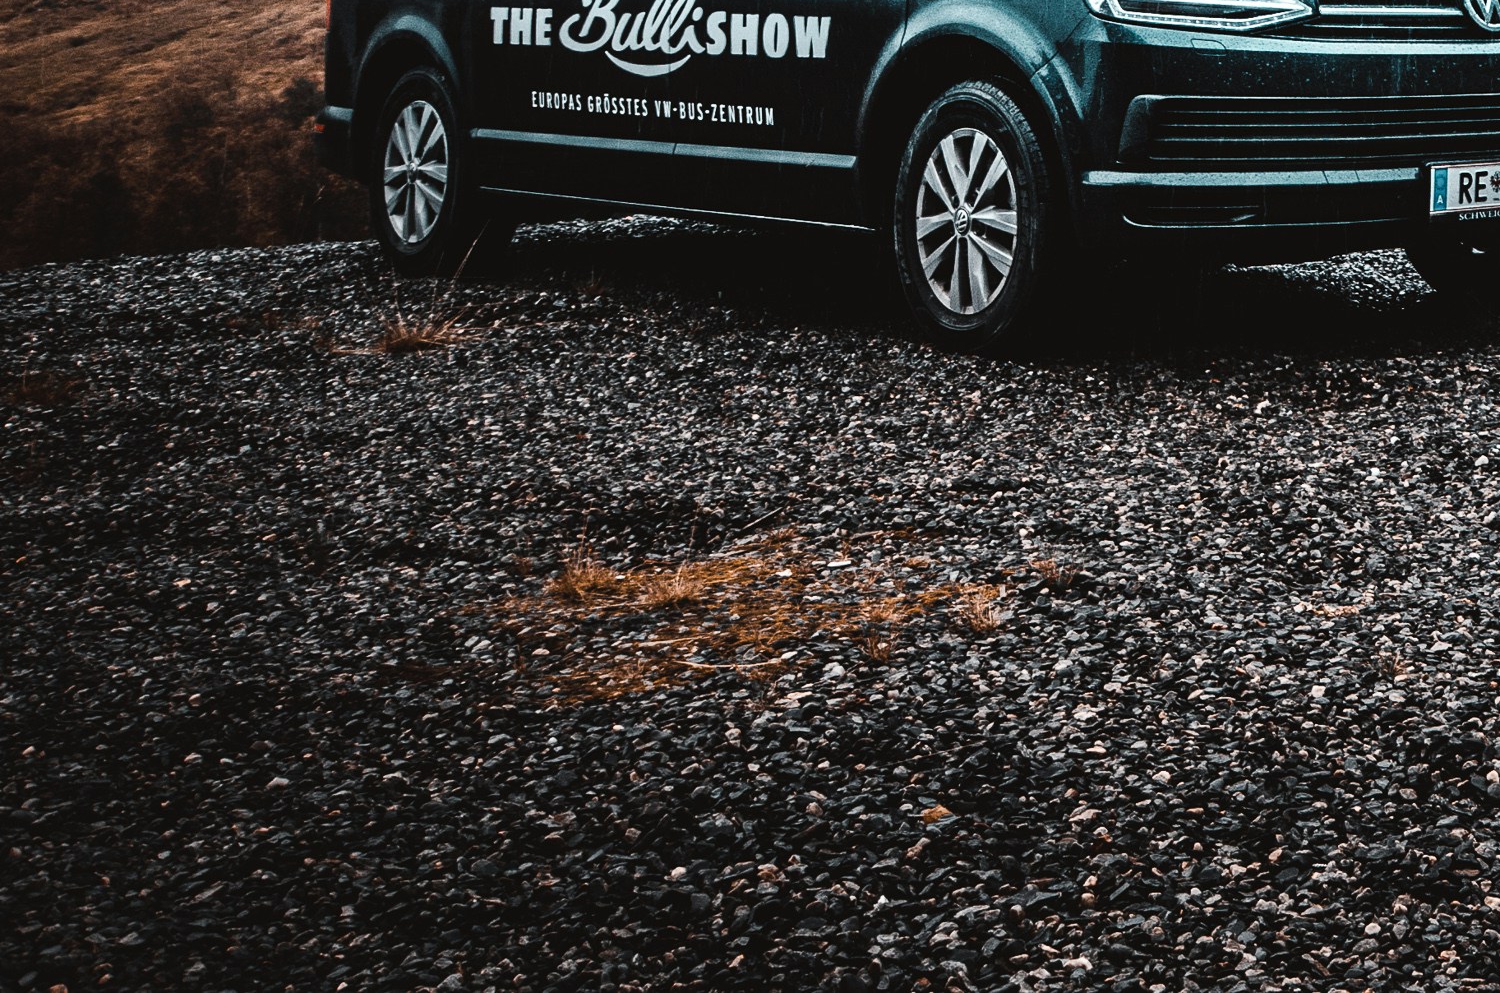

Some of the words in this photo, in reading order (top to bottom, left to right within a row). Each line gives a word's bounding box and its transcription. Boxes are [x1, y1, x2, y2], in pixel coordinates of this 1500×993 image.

[490, 7, 553, 46] THE
[706, 11, 831, 58] SHOW
[531, 90, 582, 112] EUROPAS
[587, 92, 648, 117] GRÖSSTES
[654, 100, 775, 126] VW-BUS-ZENTRUM
[1437, 194, 1444, 204] A
[1458, 170, 1488, 204] RE
